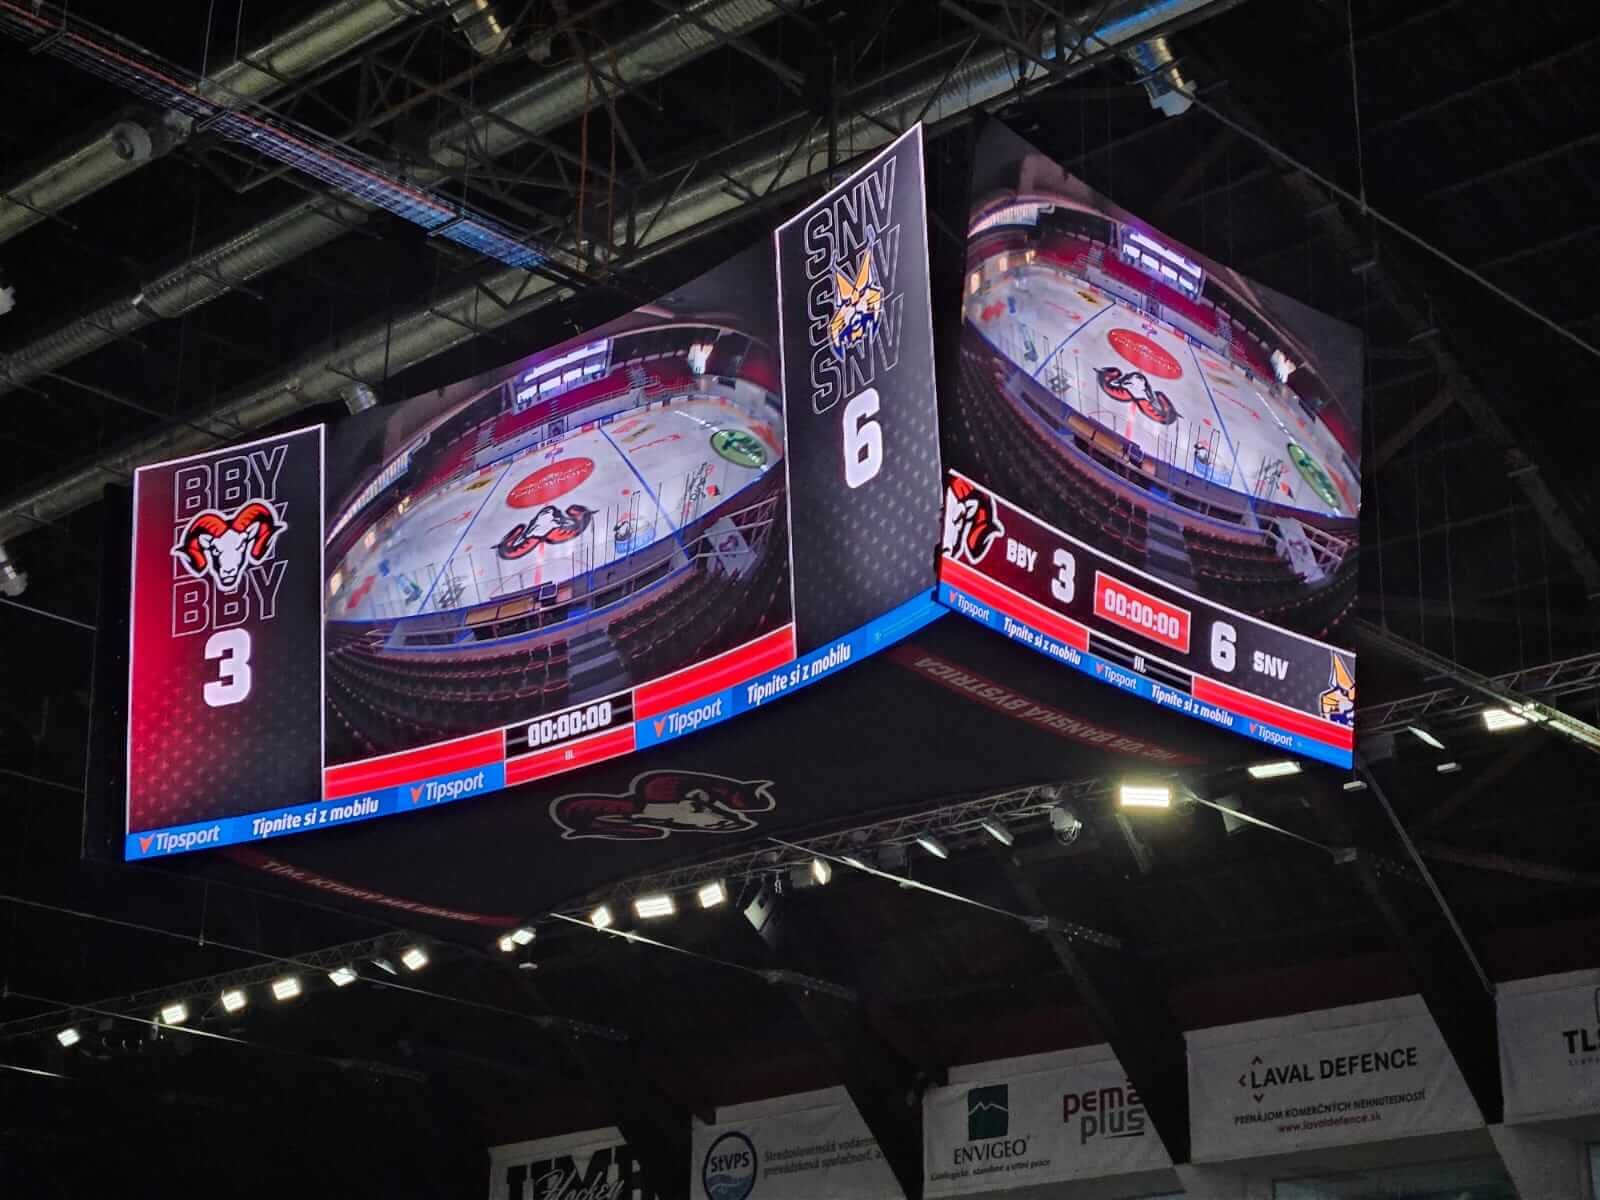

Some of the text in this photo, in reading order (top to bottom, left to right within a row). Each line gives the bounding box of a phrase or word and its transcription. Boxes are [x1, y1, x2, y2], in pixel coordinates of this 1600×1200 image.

[804, 155, 897, 280] SNV
[843, 387, 883, 489] 6
[175, 444, 288, 525] BBY
[1006, 539, 1038, 572] BBY
[1051, 548, 1076, 604] 3
[172, 559, 288, 638] BBY
[957, 594, 990, 621] Tipsport
[1103, 588, 1180, 640] 00:00:00
[1003, 616, 1081, 665] Tipnite si z mobilu
[1211, 621, 1237, 673] 6
[203, 628, 251, 708] 3
[746, 644, 851, 704] Tipnite si z mobilu
[913, 656, 1033, 711] BYSTRICA
[1103, 665, 1137, 690] Tipsport
[1253, 650, 1289, 681] SNV
[528, 702, 611, 747] 00:00:00
[667, 699, 722, 735] Tipsport
[1151, 684, 1233, 727] Tipnite si z mobilu
[1257, 724, 1293, 748] Tipsport
[425, 772, 484, 802] Tipsport
[156, 825, 221, 853] Tipsport
[251, 797, 379, 839] Tipnite si z mobilu
[1250, 1047, 1418, 1089] LAVAL DEFENCE
[1080, 1107, 1145, 1144] plus
[711, 1151, 749, 1173] StVPS
[954, 1138, 1028, 1165] ENVIGEO
